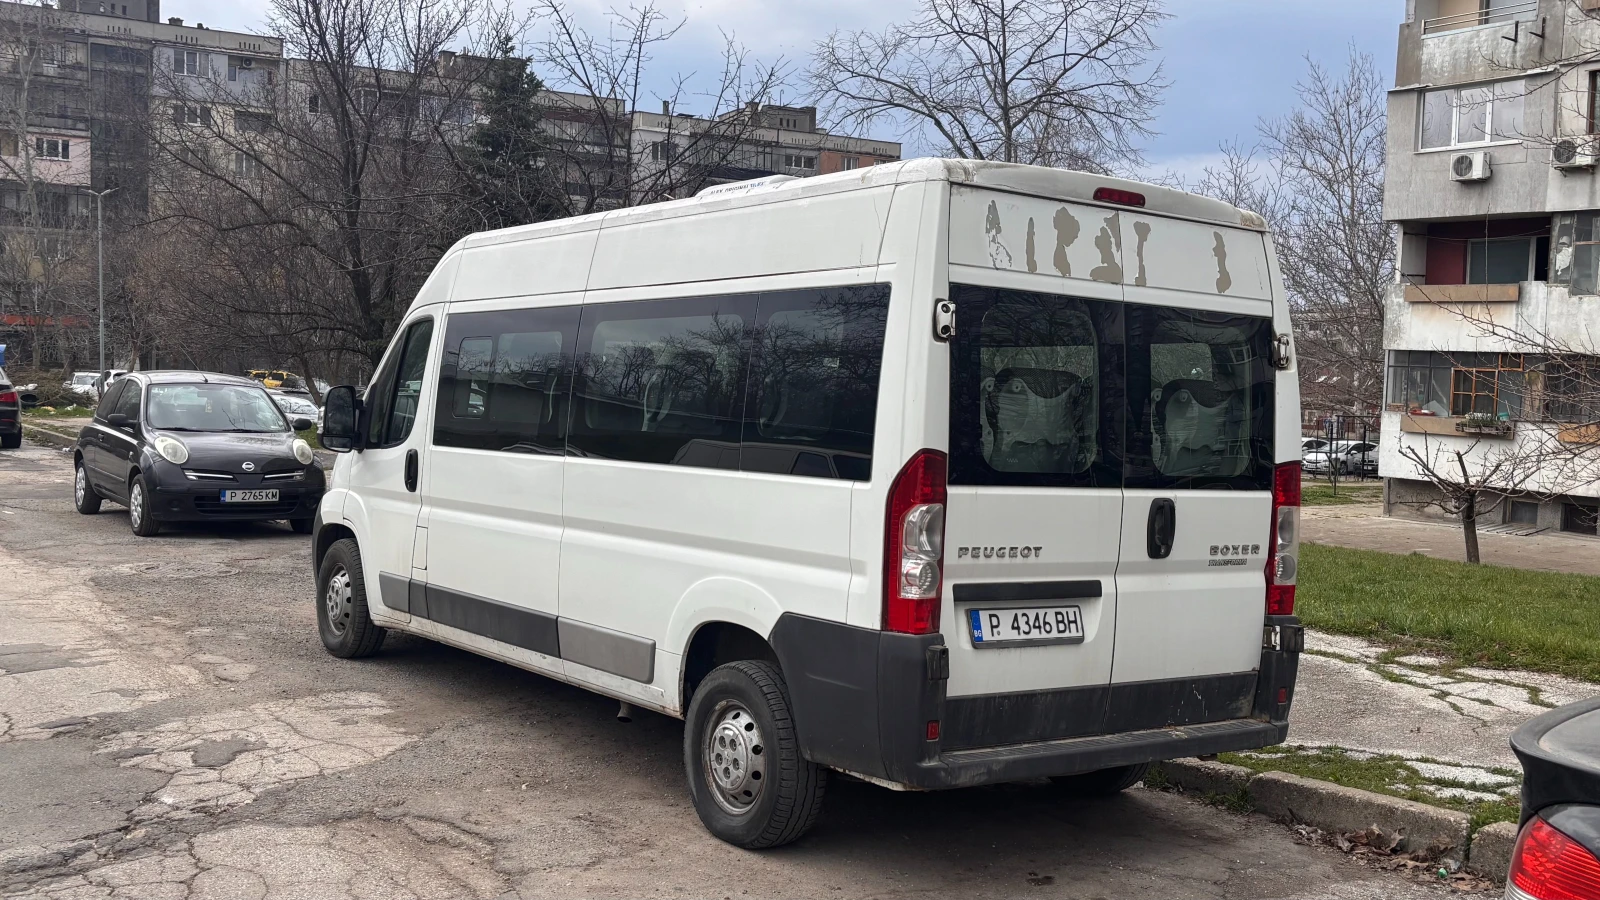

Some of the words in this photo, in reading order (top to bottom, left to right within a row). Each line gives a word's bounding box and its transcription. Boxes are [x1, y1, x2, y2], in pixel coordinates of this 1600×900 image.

[230, 491, 237, 501] P
[957, 546, 1043, 559] PEUGEOT
[1209, 544, 1261, 556] BOXER
[973, 629, 982, 637] BG
